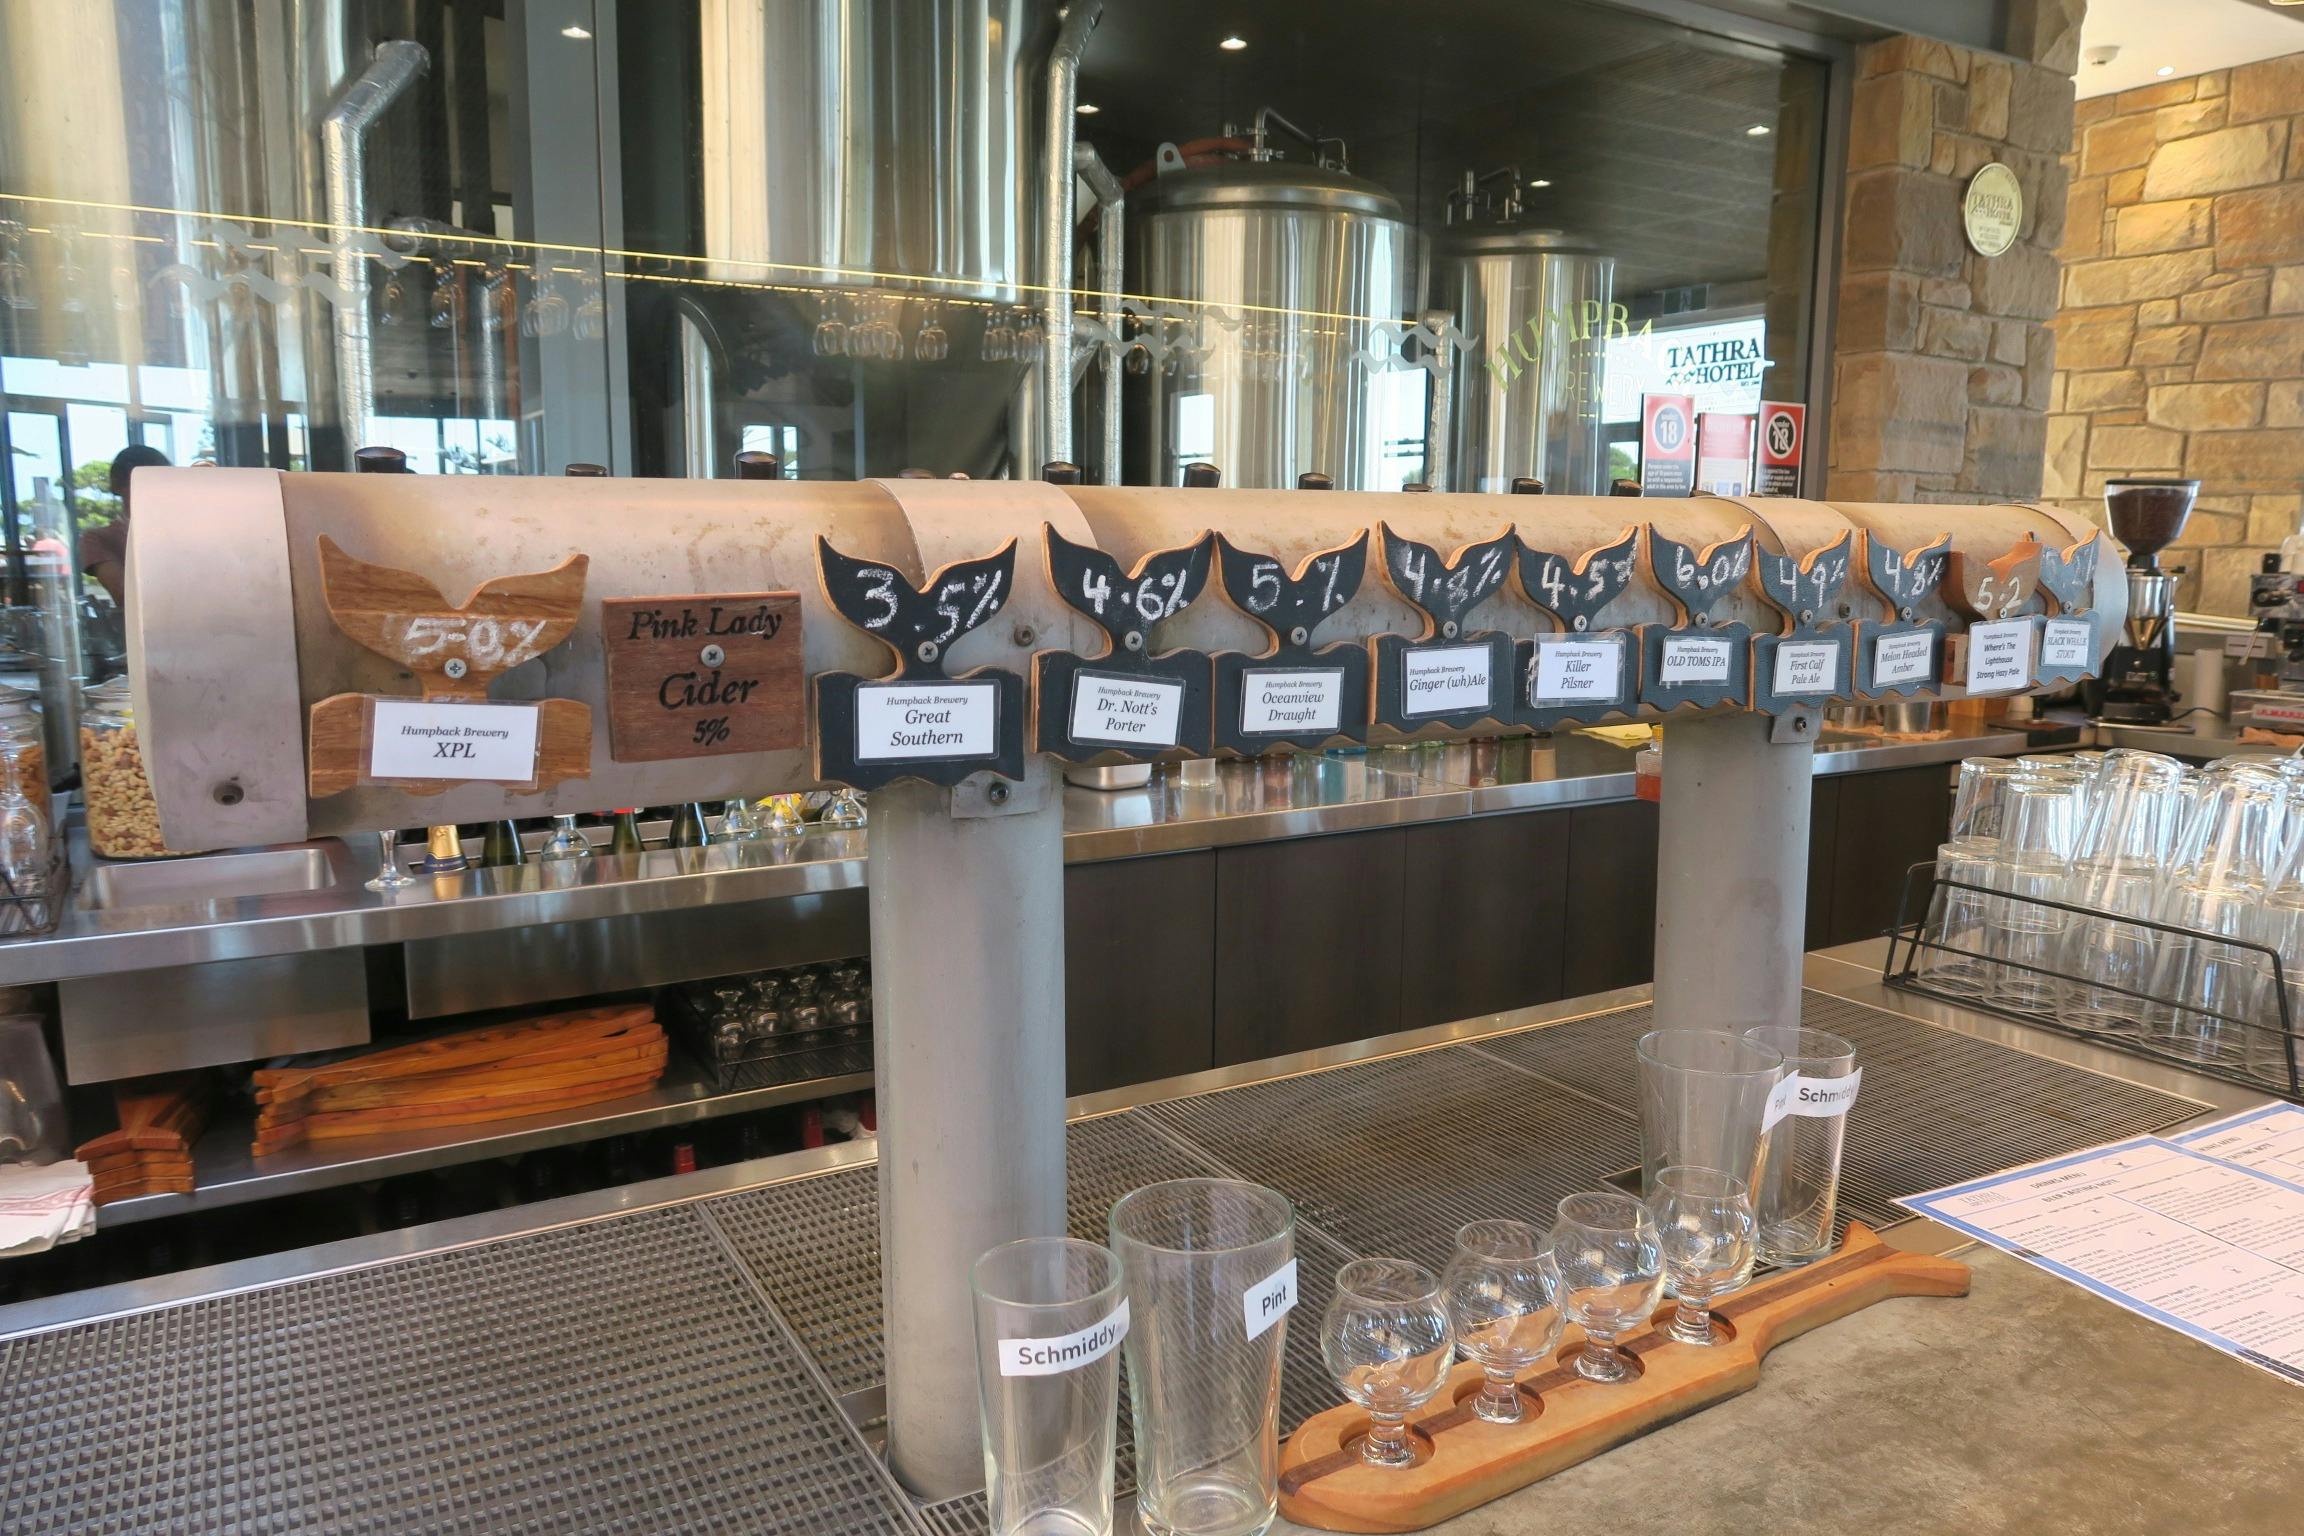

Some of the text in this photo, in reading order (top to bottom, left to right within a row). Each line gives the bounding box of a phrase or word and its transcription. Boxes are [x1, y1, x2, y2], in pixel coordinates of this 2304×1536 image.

[1667, 338, 1761, 368] TATHRA
[1695, 361, 1760, 384] HOTEL
[1660, 421, 1677, 443] 18
[1676, 543, 1748, 589] 6.0%
[1779, 556, 1845, 609] 4.9%
[1082, 567, 1190, 621] 4.6%
[1973, 576, 2022, 611] 5.2
[857, 569, 1001, 644] 3.5%
[628, 605, 782, 640] Pink Lady
[1984, 641, 2016, 652] Where's The
[1666, 655, 1726, 667] OLD TOMS IPA
[1880, 647, 1928, 663] Melon Headed
[1985, 656, 2014, 667] Lighthouse
[2056, 650, 2076, 659] STOUT
[1409, 665, 1466, 676] Humpback Brewery
[1565, 660, 1592, 673] Killer
[1790, 659, 1825, 671] First Calf
[1891, 663, 1914, 675] Amber
[1791, 673, 1820, 684] Pale Ale
[1976, 668, 2020, 680] Strong Hazy Pale
[659, 670, 759, 710] Cider
[1265, 681, 1323, 690] Humpback Brewery
[1409, 674, 1487, 693] Ginger (wh)Ale
[1560, 677, 1594, 689] Pilsner
[886, 696, 968, 706] Humpback Brewery
[1097, 686, 1161, 701] Humpback Brewery
[1262, 691, 1324, 704] Oceanview
[1096, 698, 1158, 715] Dr. Nott's
[905, 709, 951, 724] Great
[1268, 708, 1316, 722] Draught
[401, 726, 509, 739] Humpback Brewery
[693, 716, 730, 746] 5%
[1105, 717, 1146, 733] Porter
[890, 730, 964, 746] Southern
[433, 743, 476, 758] XPL
[1261, 1285, 1287, 1316] Pint
[1018, 1323, 1116, 1365] Schmiddy
